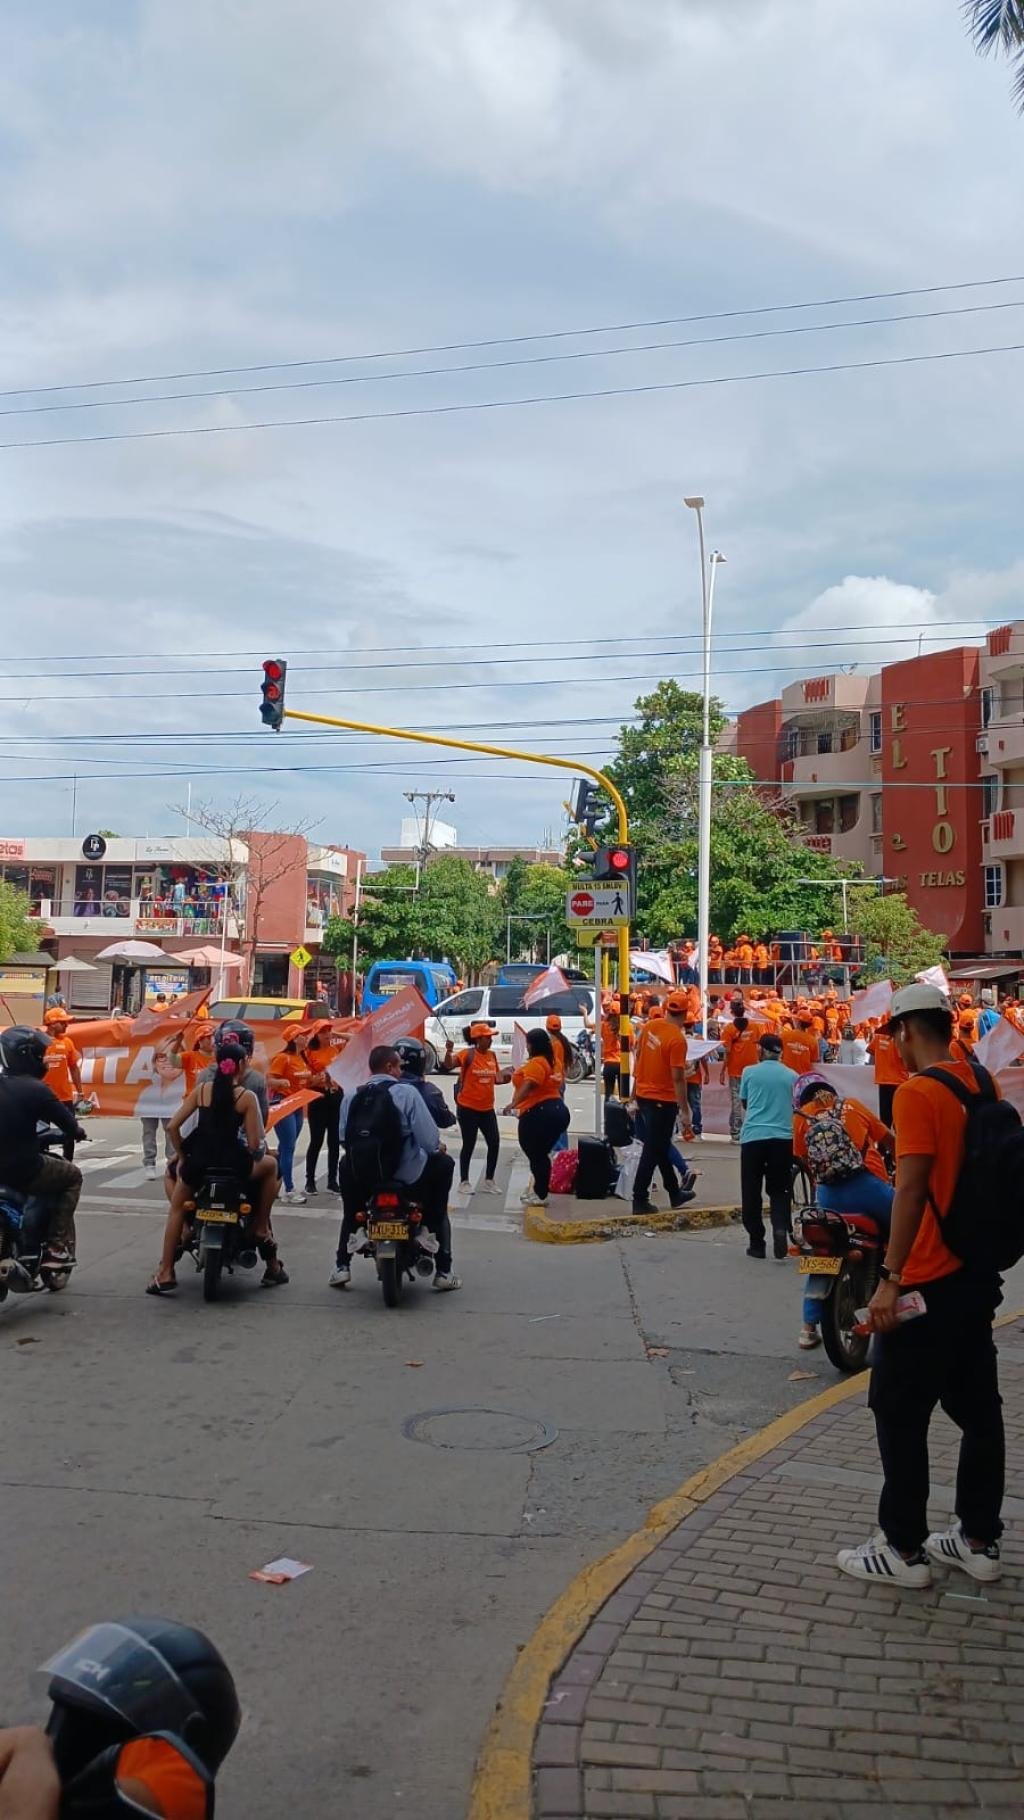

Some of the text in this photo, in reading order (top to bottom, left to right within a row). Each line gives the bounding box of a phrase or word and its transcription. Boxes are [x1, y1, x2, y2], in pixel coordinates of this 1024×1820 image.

[892, 702, 908, 770] EL
[930, 747, 953, 853] TIO
[920, 871, 965, 887] TELAS
[78, 1045, 155, 1084] ITA
